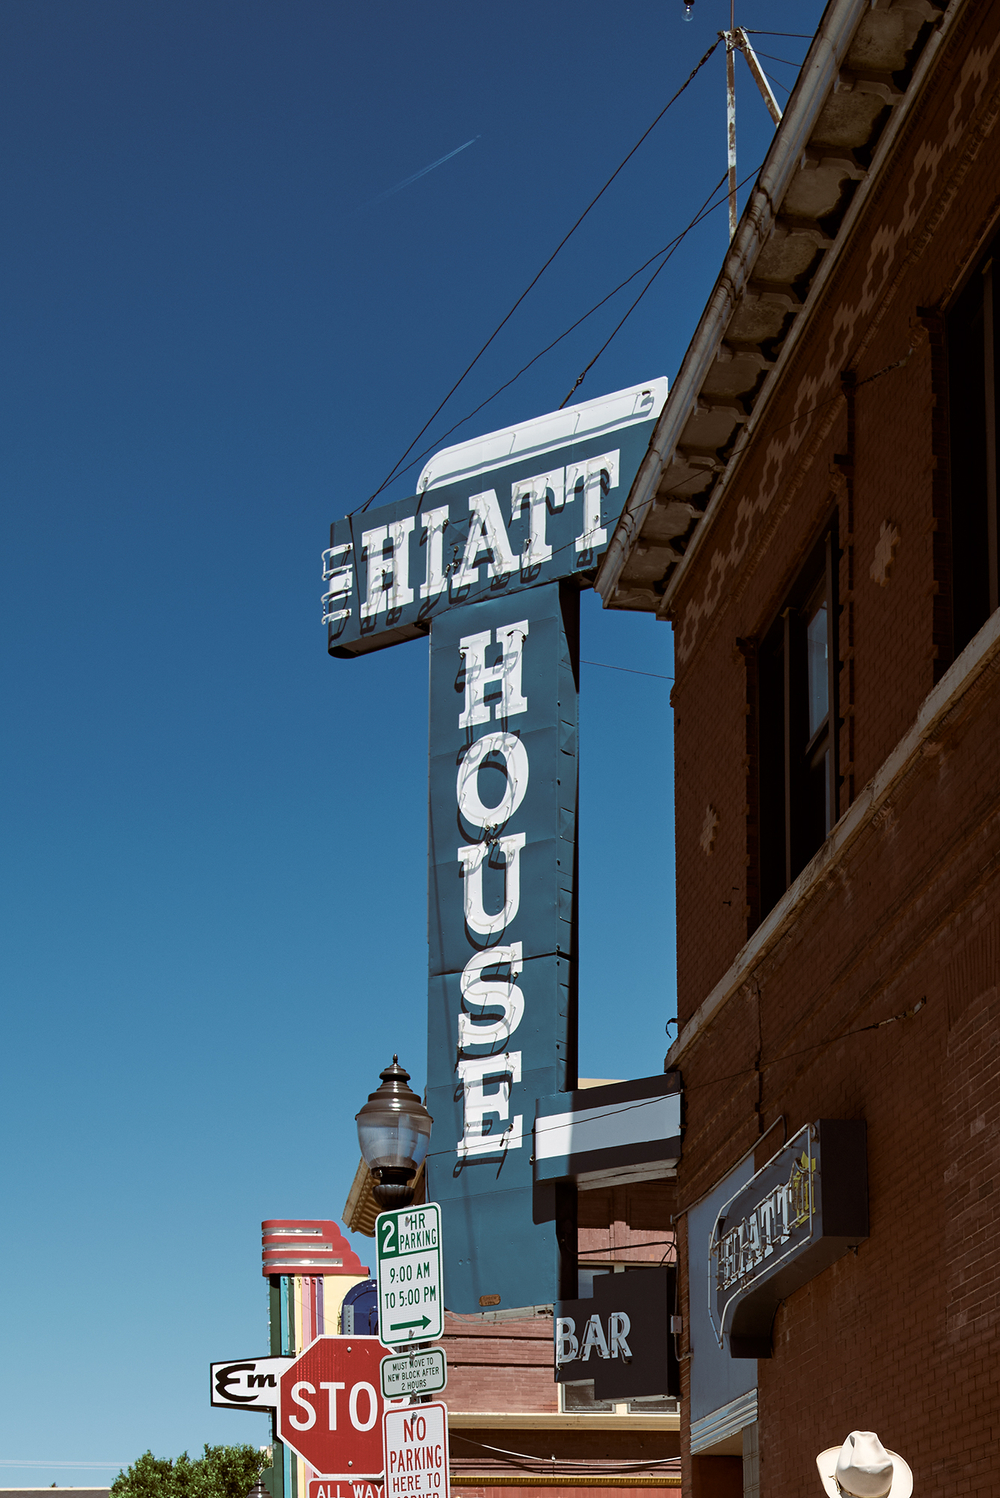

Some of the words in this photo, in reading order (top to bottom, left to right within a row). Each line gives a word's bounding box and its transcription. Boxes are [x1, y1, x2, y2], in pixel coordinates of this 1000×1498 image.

[360, 448, 621, 619] HIATT
[456, 619, 530, 1158] HOUSE
[381, 1220, 396, 1254] 2
[409, 1213, 426, 1231] HR
[399, 1228, 437, 1250] PARKING
[389, 1264, 412, 1284] 9:00
[416, 1261, 430, 1280] AM
[384, 1292, 396, 1309] TO
[399, 1287, 420, 1308] 5:00
[423, 1285, 437, 1303] PM
[556, 1311, 633, 1364] BAR
[387, 1373, 400, 1383] NEW
[401, 1370, 420, 1380] BLOCK
[422, 1366, 440, 1377] AFTER
[392, 1361, 407, 1371] MUST
[409, 1358, 425, 1368] MOVE
[426, 1356, 434, 1366] TO
[401, 1382, 406, 1391] 2
[407, 1379, 427, 1390] HOURS
[289, 1381, 410, 1432] STO
[403, 1416, 427, 1443] NO
[389, 1444, 442, 1474] PARKING
[392, 1474, 421, 1493] HERE
[427, 1472, 441, 1489] TO
